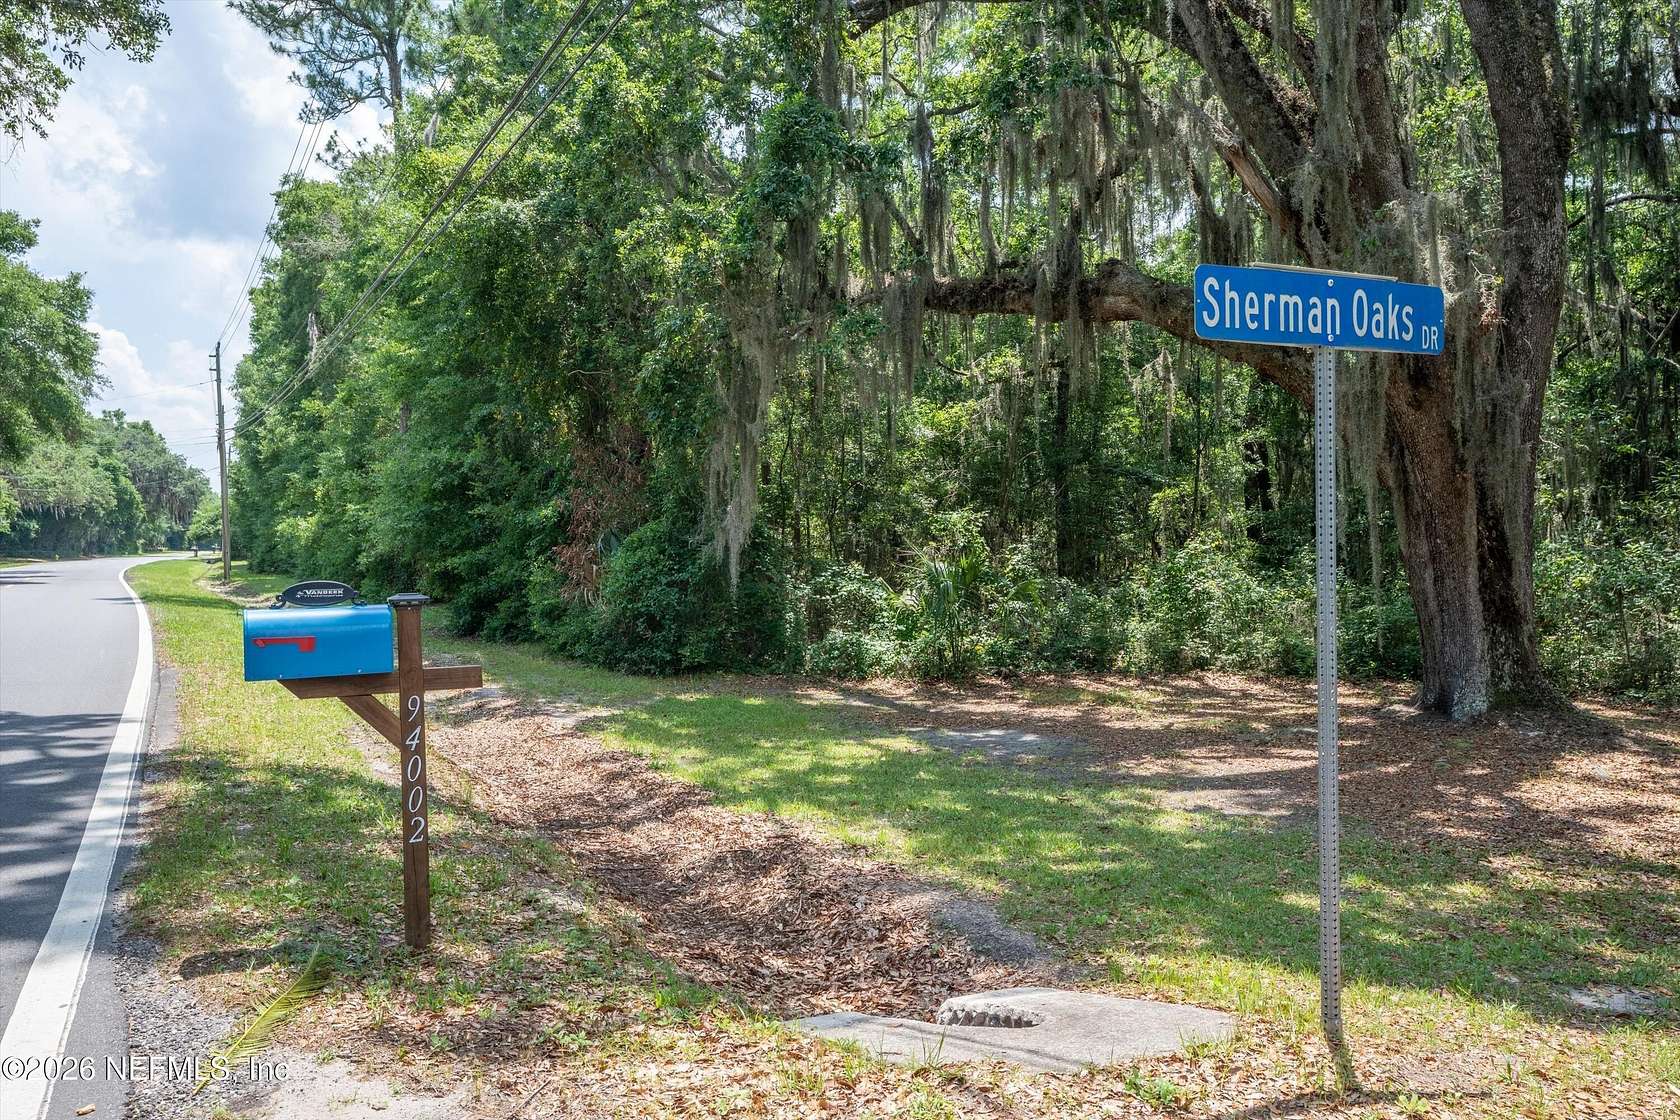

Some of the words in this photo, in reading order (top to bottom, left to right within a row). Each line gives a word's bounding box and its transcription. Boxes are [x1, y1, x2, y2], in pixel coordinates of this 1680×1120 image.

[1202, 276, 1341, 336] Sherman
[1352, 288, 1414, 342] Oaks
[1421, 325, 1439, 350] DR
[405, 695, 425, 843] 94002
